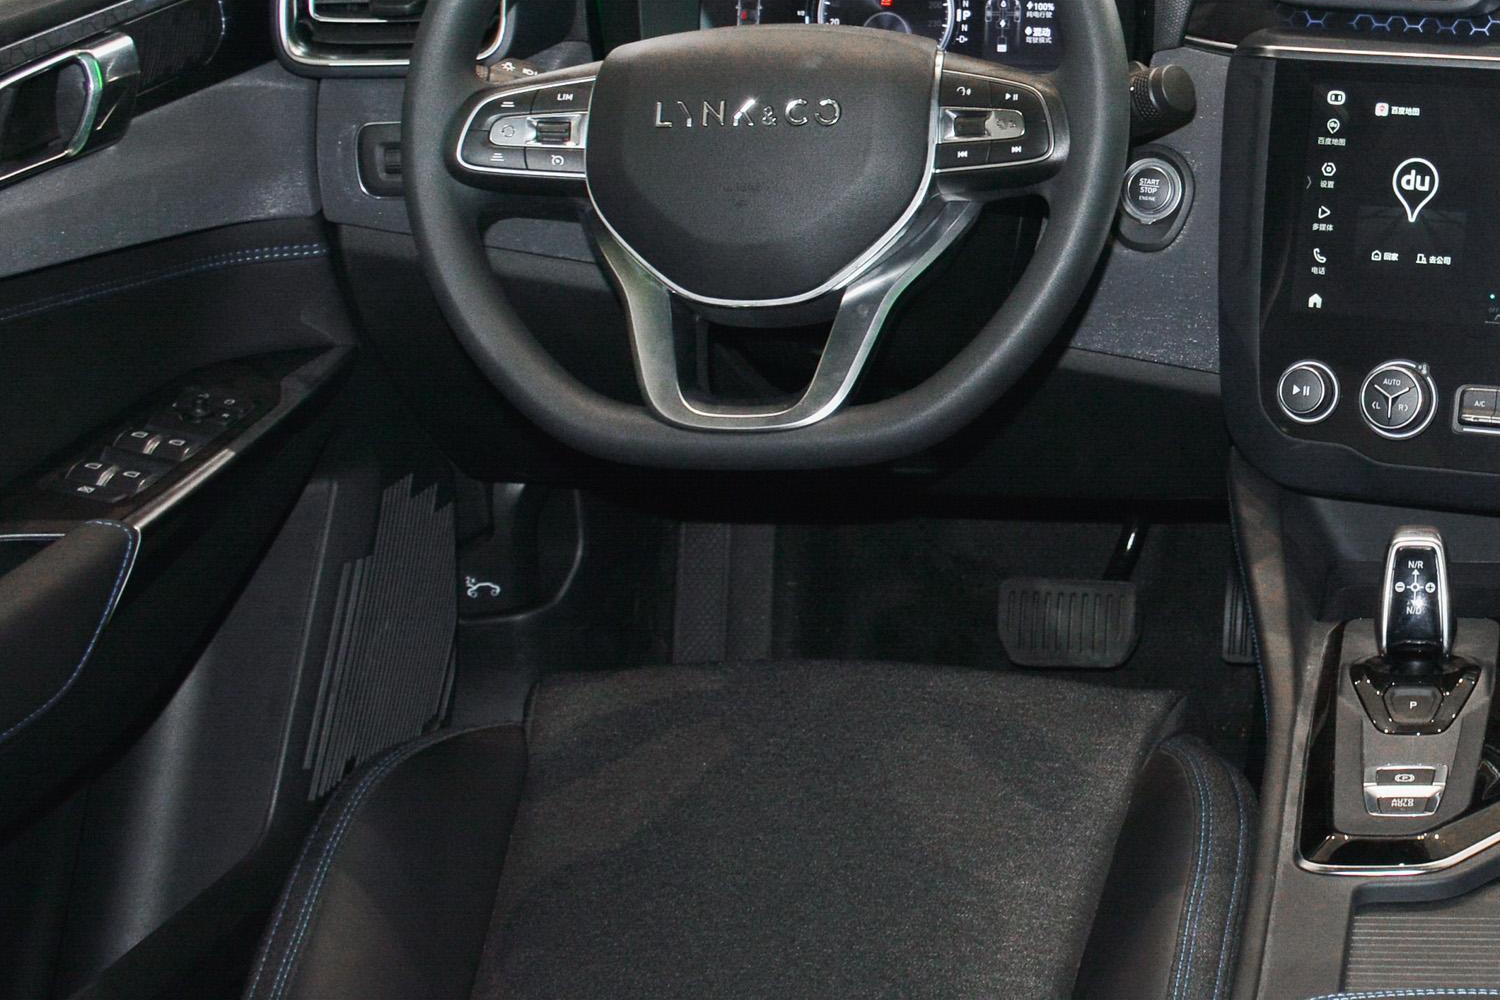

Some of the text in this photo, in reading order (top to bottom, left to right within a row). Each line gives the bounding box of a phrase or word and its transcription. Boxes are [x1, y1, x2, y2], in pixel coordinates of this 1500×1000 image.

[962, 0, 969, 8] N
[962, 10, 971, 20] P
[961, 24, 968, 32] N
[557, 93, 574, 101] LIM
[1139, 178, 1160, 186] START
[1320, 180, 1335, 189] 设置
[1400, 169, 1431, 192] du
[1140, 186, 1158, 194] STOP
[1311, 266, 1326, 275] 电话
[1383, 377, 1401, 386] AUTO
[1474, 400, 1486, 408] A/C
[1407, 560, 1424, 569] N/R
[1409, 701, 1418, 710] P
